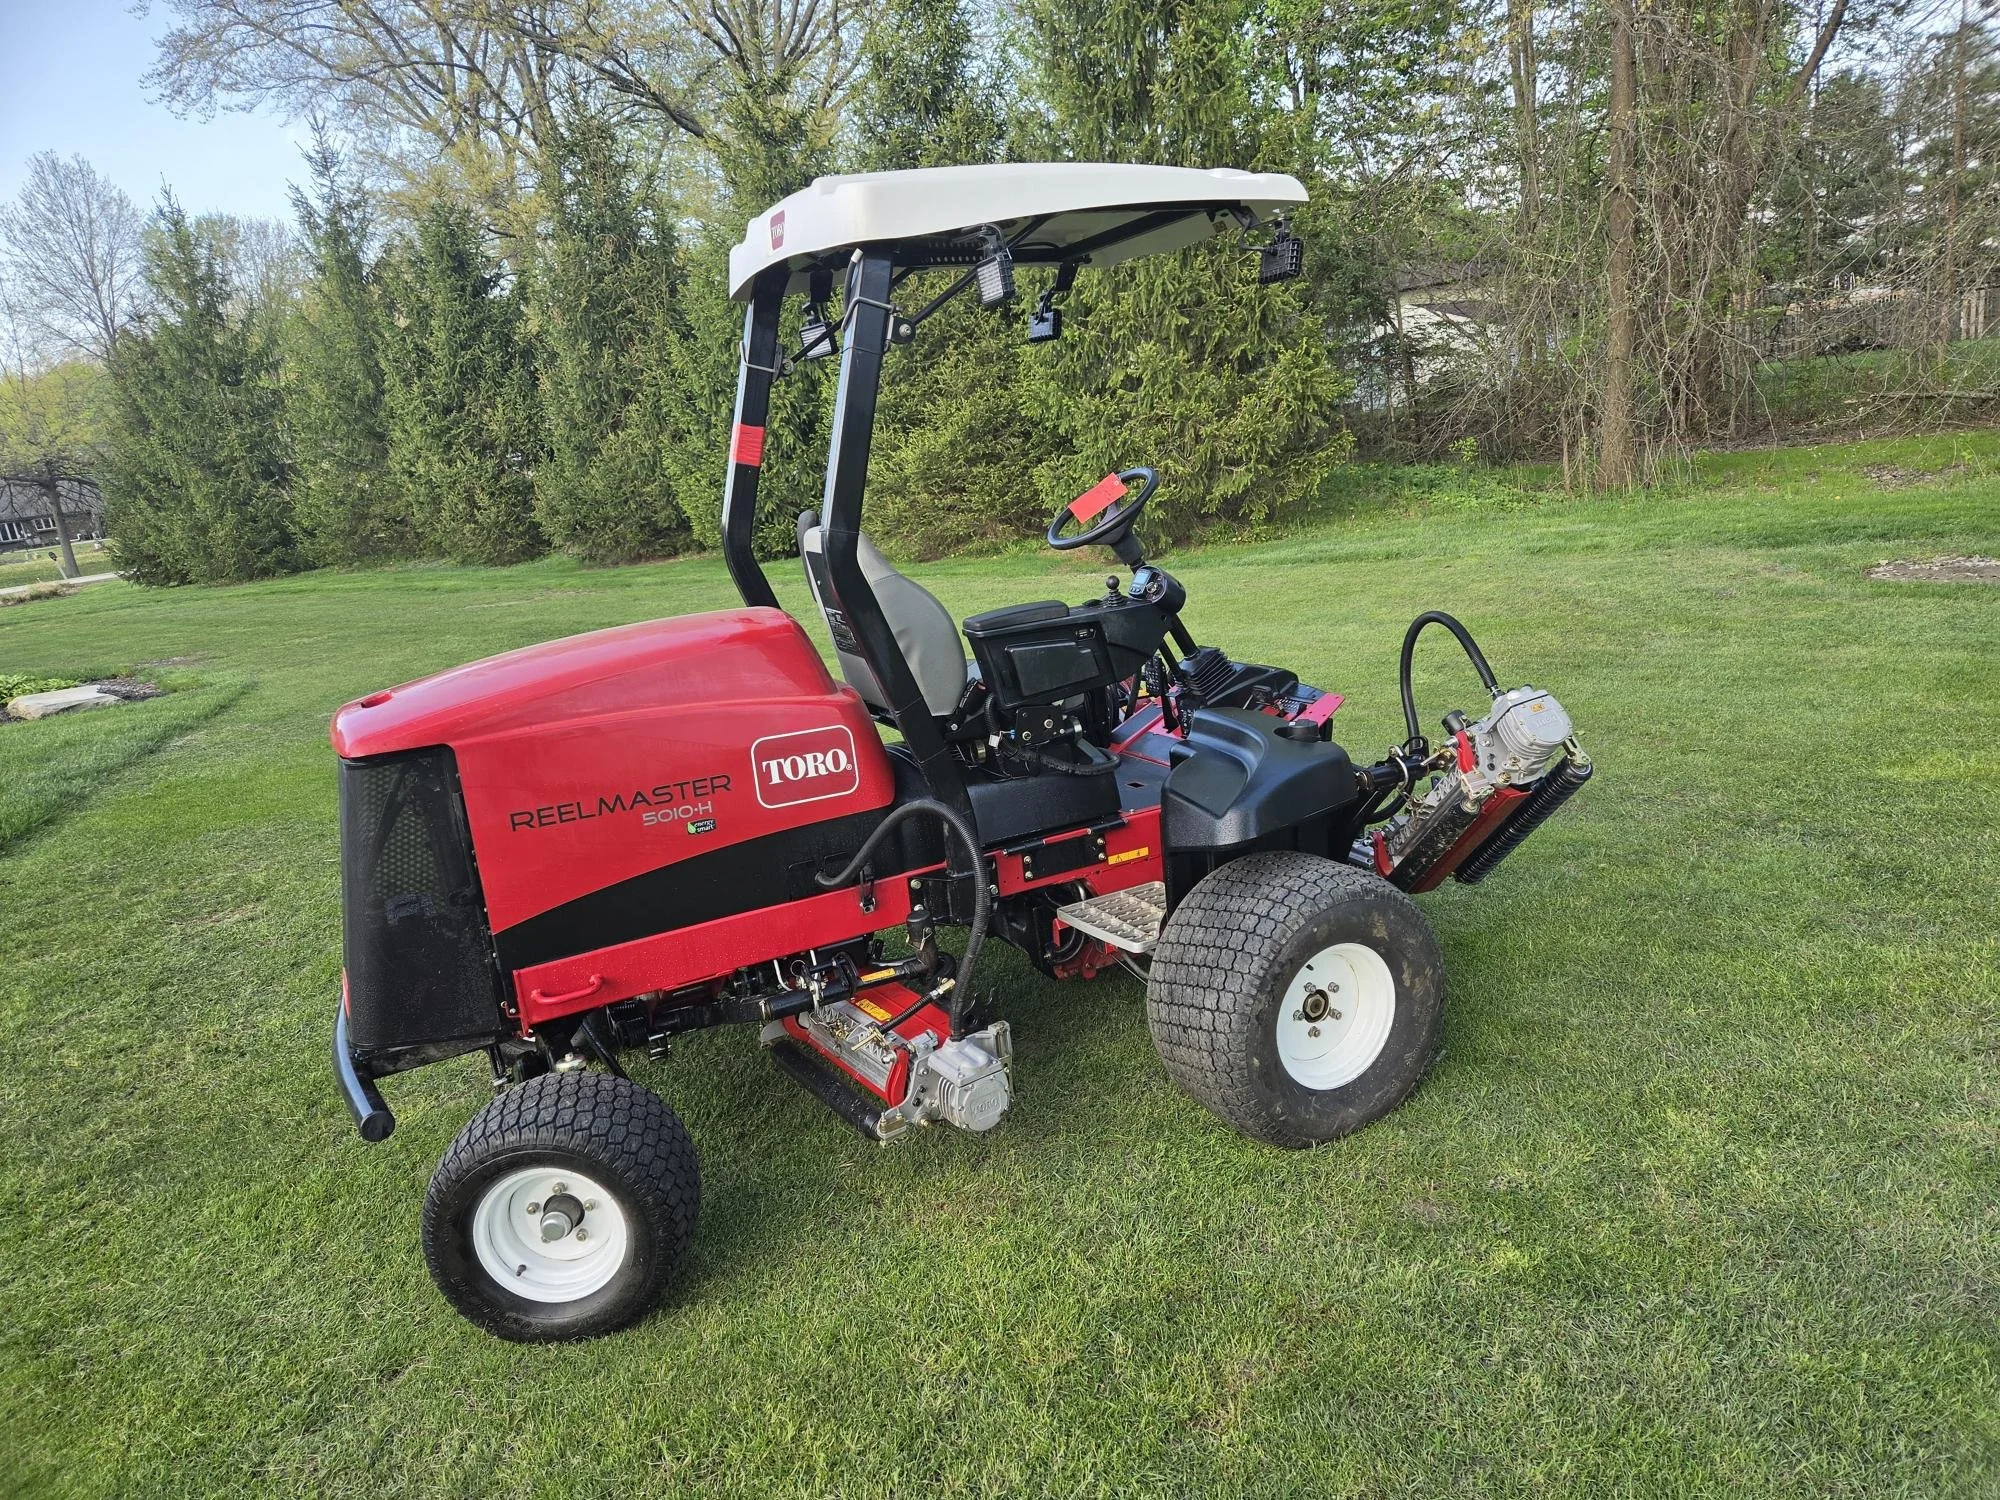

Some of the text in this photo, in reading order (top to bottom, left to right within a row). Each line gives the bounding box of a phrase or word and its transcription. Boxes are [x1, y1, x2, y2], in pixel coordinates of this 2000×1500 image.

[762, 748, 848, 785] TORO
[509, 774, 733, 832] REELMASTER
[696, 824, 714, 833] smart
